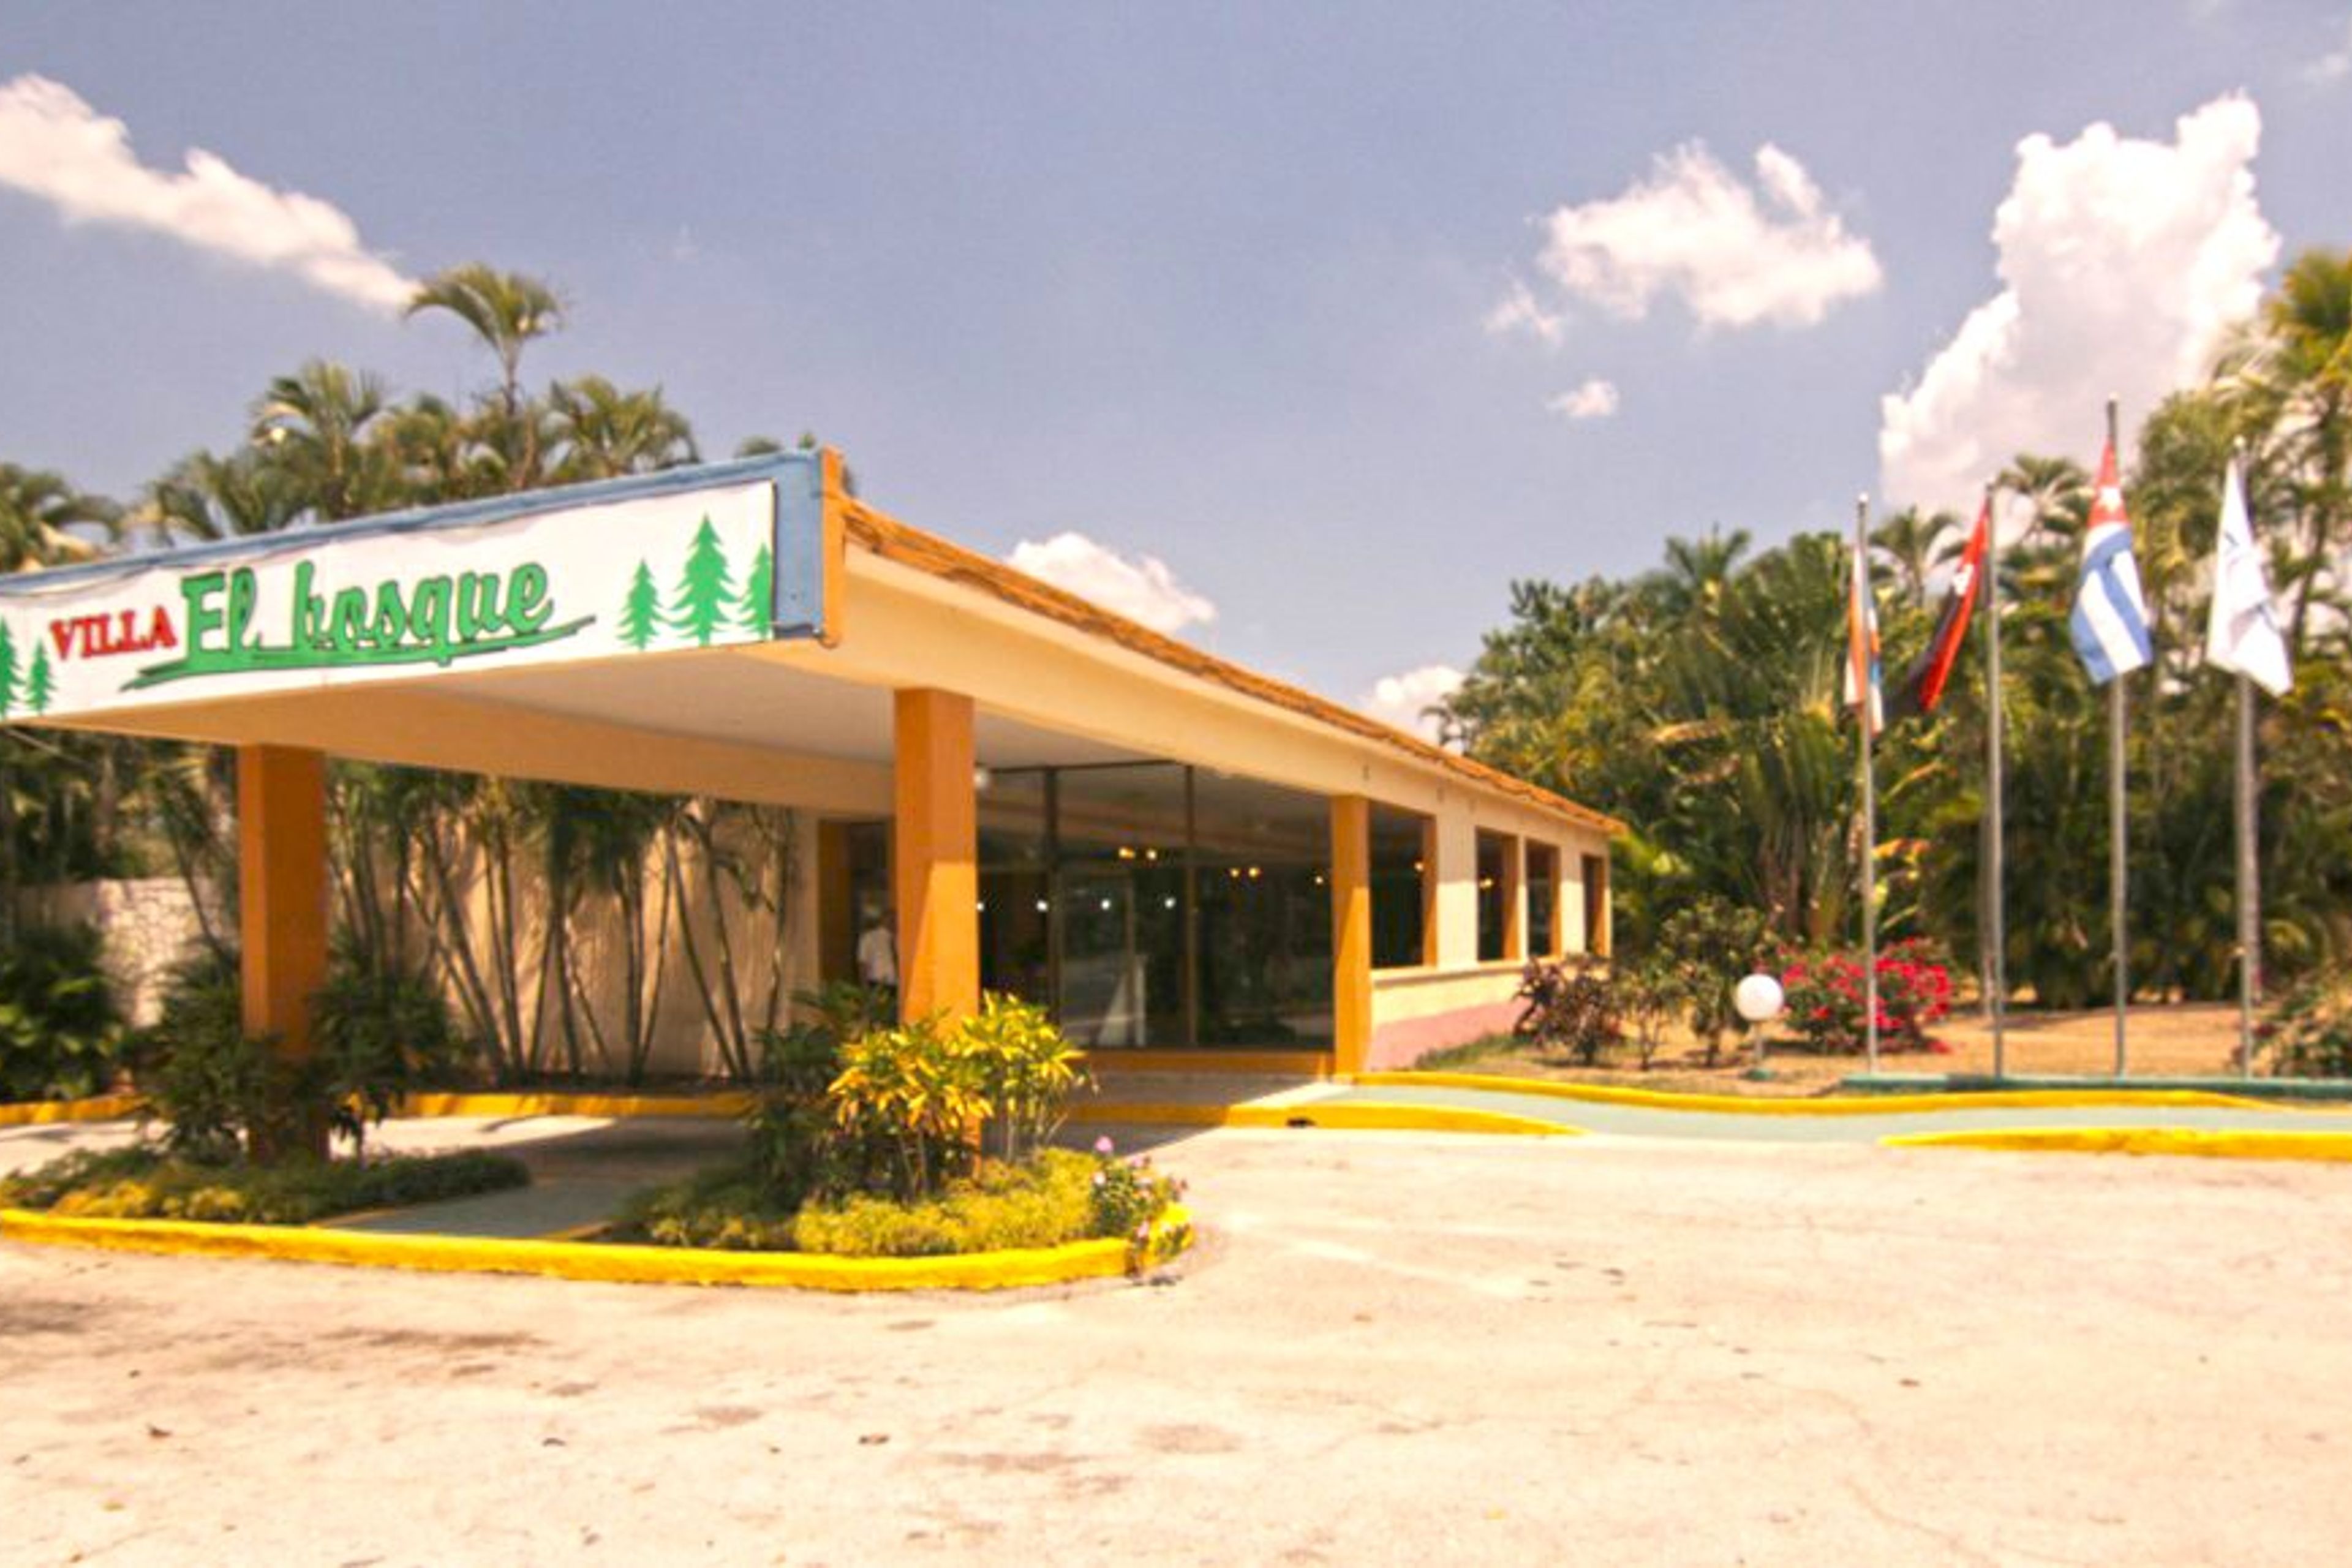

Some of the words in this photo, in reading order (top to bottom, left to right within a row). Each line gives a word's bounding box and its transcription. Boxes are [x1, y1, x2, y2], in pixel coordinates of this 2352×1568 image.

[50, 606, 176, 660] VILLA
[180, 567, 262, 669] El
[293, 559, 554, 666] bosque
